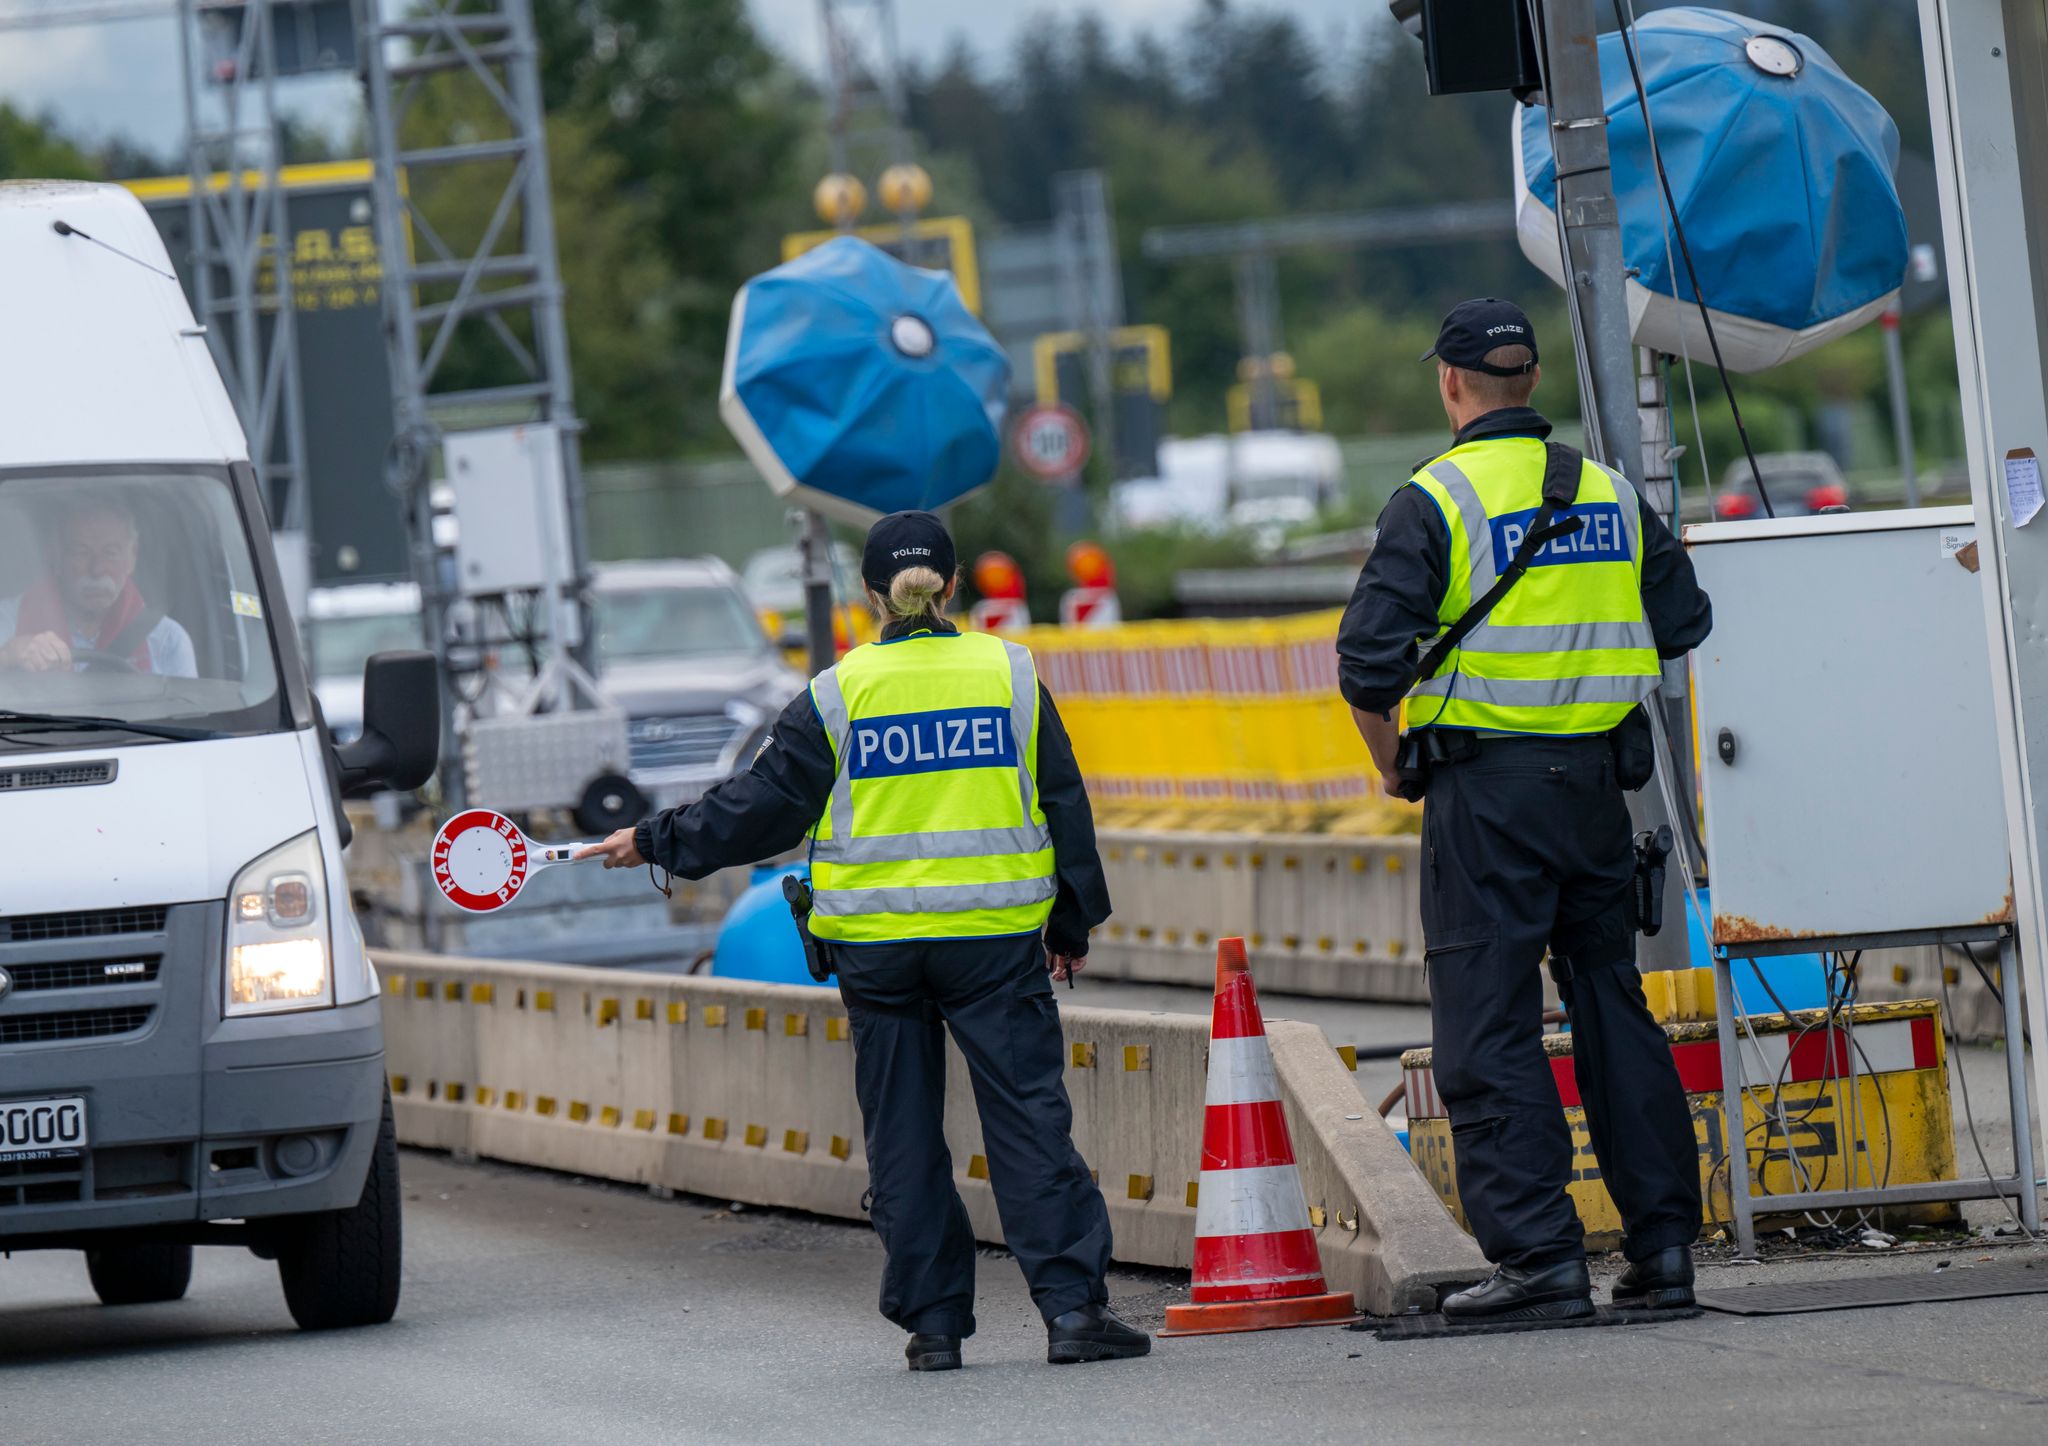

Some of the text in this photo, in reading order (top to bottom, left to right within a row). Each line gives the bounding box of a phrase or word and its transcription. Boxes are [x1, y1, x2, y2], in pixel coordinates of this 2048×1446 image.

[1486, 325, 1524, 337] POLIZEI
[892, 547, 931, 560] POLIZEI
[857, 717, 1005, 768] POLIZEI
[435, 832, 457, 894] HALT
[490, 815, 526, 903] POLIZEI
[0, 1104, 80, 1147] 000
